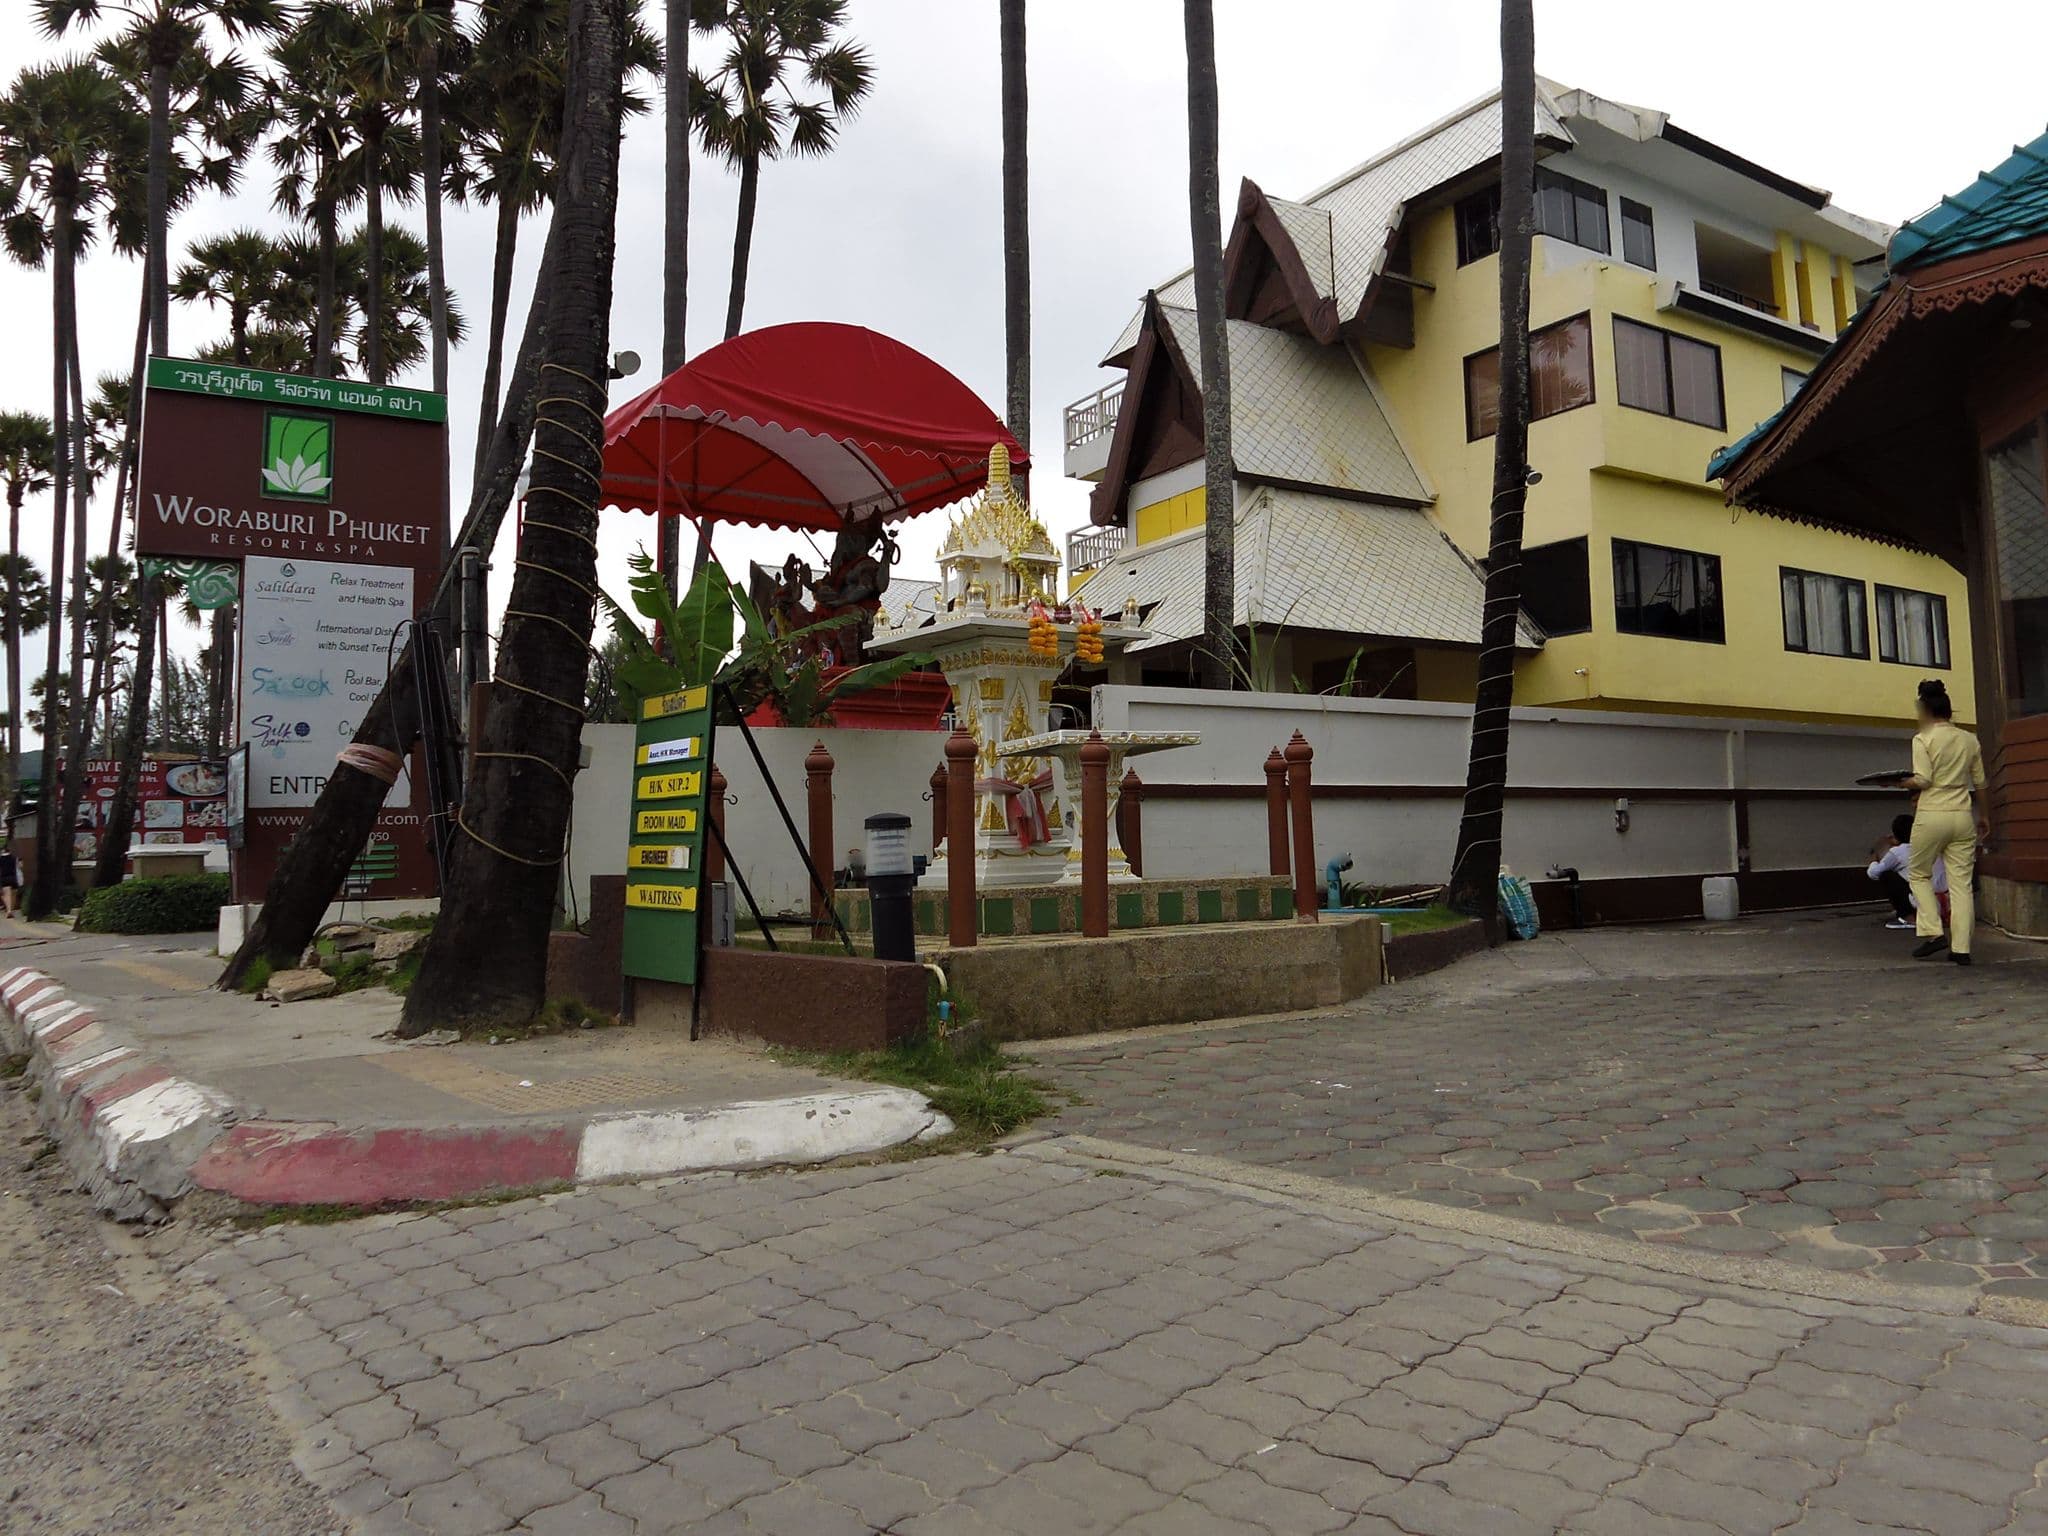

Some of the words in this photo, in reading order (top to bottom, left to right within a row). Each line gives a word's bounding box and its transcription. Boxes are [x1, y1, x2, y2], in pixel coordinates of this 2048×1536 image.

[390, 397, 422, 412] สปา
[153, 493, 314, 535] WORABURI
[327, 509, 431, 545] PHUKET
[330, 572, 357, 586] Relax
[360, 578, 405, 590] Treatment
[338, 594, 356, 603] and
[357, 595, 386, 605] Health
[387, 597, 404, 607] Spa
[315, 619, 373, 636] International
[318, 641, 337, 651] with
[338, 642, 369, 653] Sunset
[372, 644, 404, 654] Terrce
[344, 669, 364, 686] Pool
[349, 692, 370, 702] Cool
[87, 761, 111, 772] DAY
[270, 776, 328, 794] ENTR
[643, 816, 665, 830] ROOM
[667, 815, 686, 829] MAID
[639, 890, 683, 906] WAITRESS
